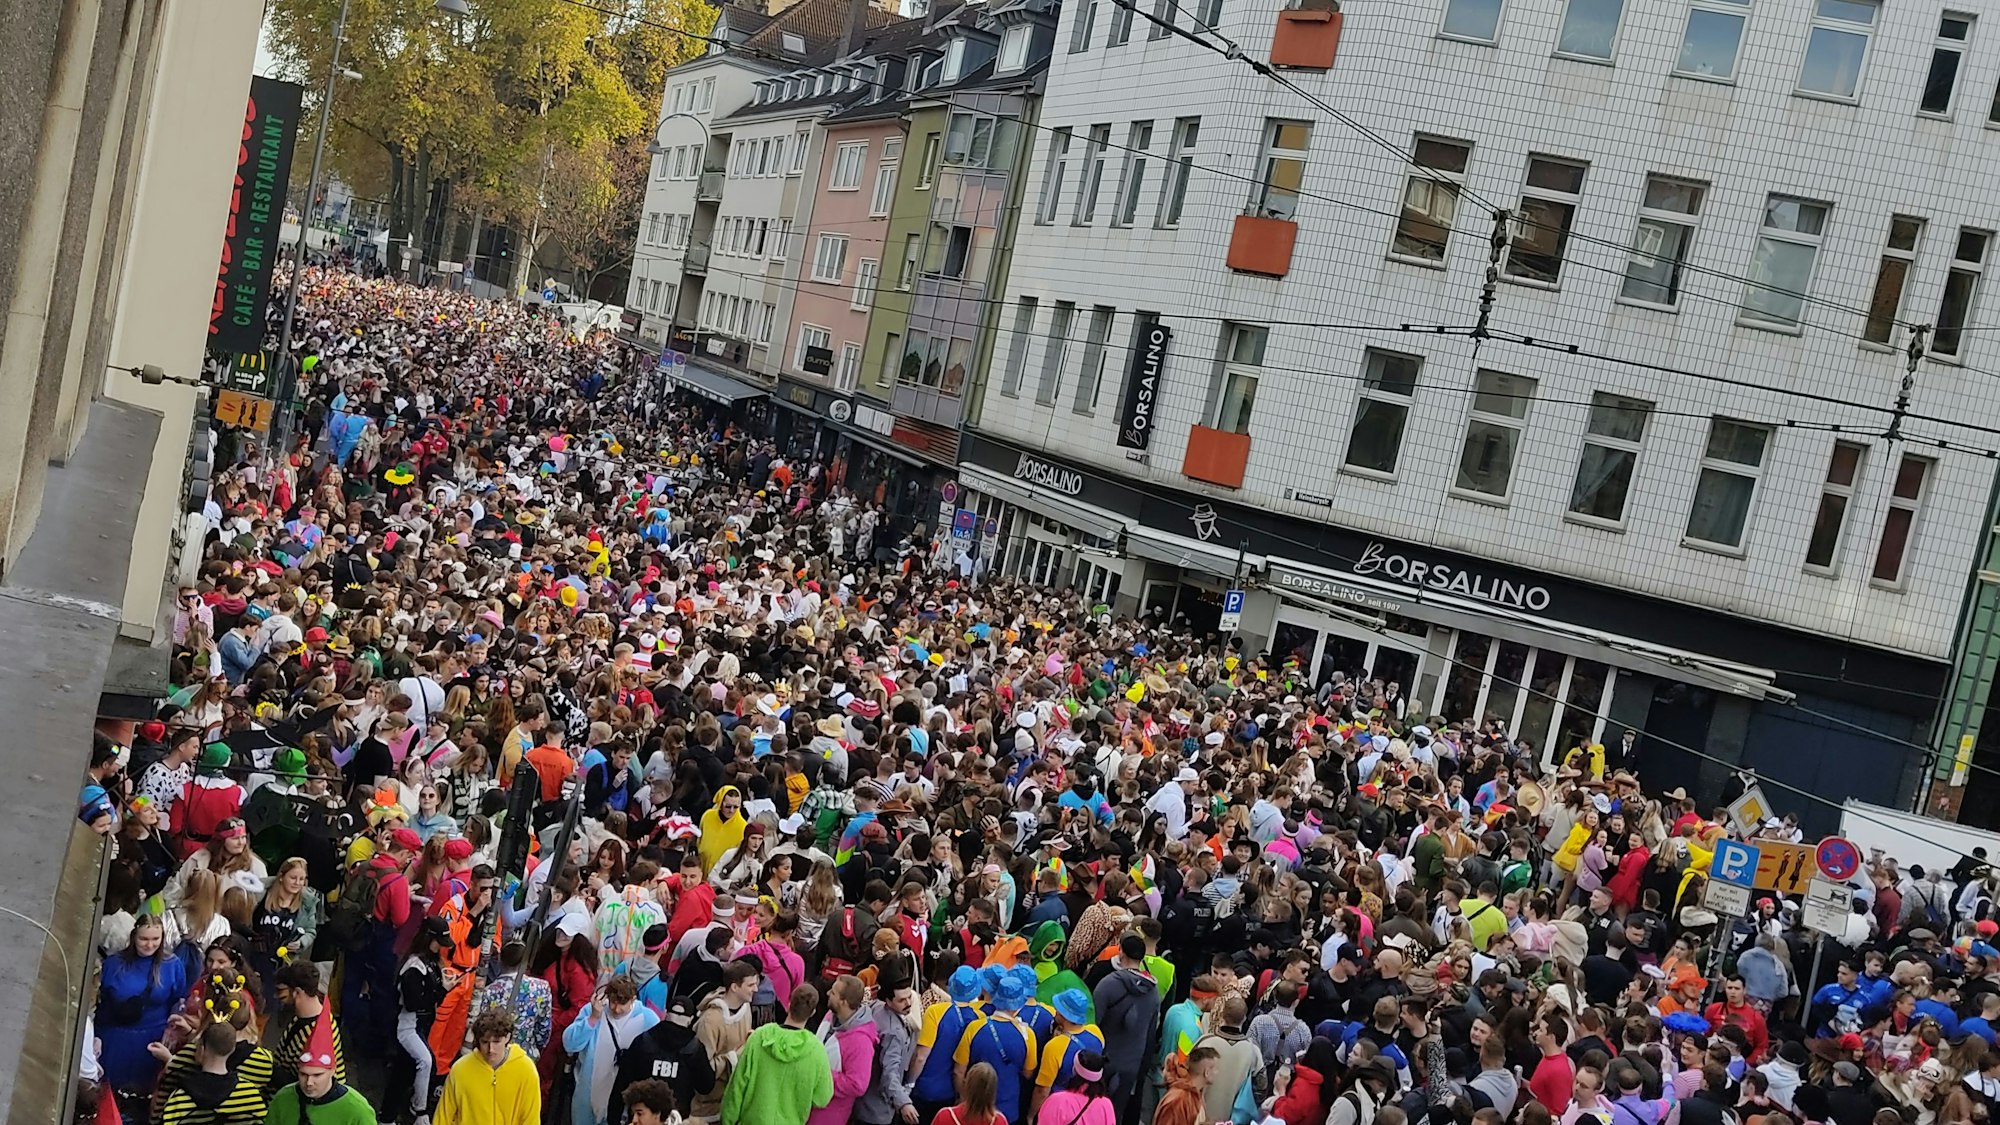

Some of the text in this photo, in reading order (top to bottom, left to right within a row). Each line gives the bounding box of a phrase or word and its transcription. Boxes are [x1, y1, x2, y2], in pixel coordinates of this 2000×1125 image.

[233, 114, 285, 327] CAFÉ BAR RESTAURANT
[1124, 329, 1164, 447] BORSALINO
[1014, 453, 1083, 496] BORSALINO
[1281, 574, 1366, 603] BORSALINO
[1368, 599, 1382, 609] seit
[1353, 540, 1550, 611] BORSALINO
[1228, 593, 1240, 611] P
[1721, 845, 1749, 875] P
[652, 1059, 679, 1078] FBI
